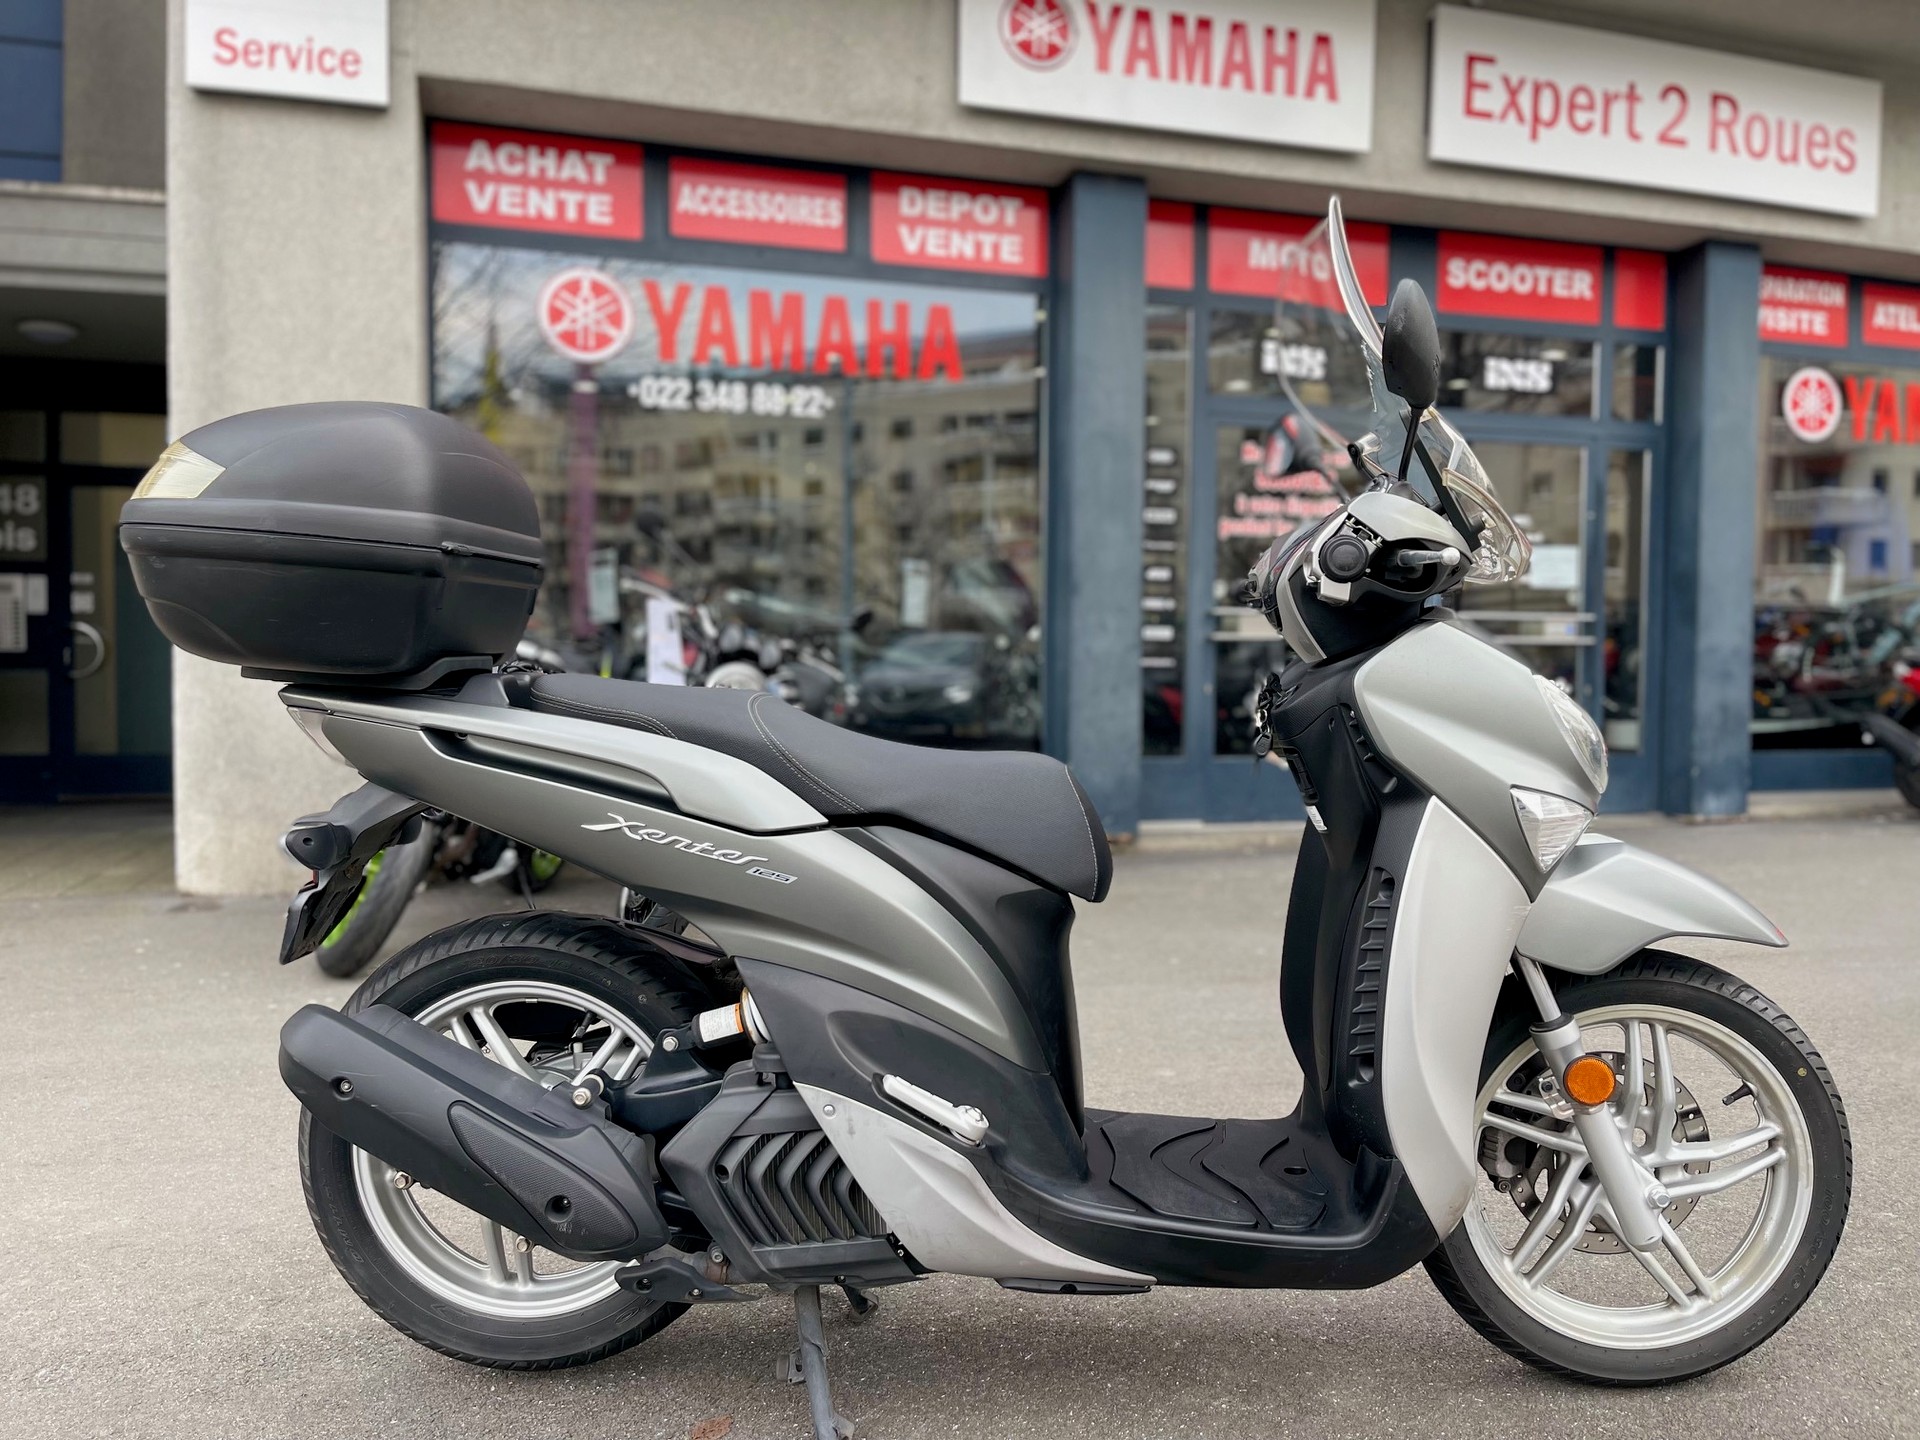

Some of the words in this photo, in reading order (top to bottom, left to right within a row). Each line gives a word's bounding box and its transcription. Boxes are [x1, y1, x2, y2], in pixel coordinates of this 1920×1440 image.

[213, 27, 362, 79] Service
[1085, 0, 1340, 103] YAMAHA
[1463, 52, 1643, 142] Expert
[1656, 84, 1690, 149] 2
[1709, 93, 1858, 175] Roues
[464, 138, 615, 186] ACHAT
[464, 180, 615, 226] VENTE
[676, 182, 844, 230] ACCESSOIRES
[898, 186, 1023, 227] DEPOT
[898, 223, 1024, 264] VENTE
[1446, 256, 1594, 301] SCOOTER
[643, 279, 963, 383] YAMAHA
[581, 812, 769, 865] Xenter
[750, 867, 795, 884] 125
